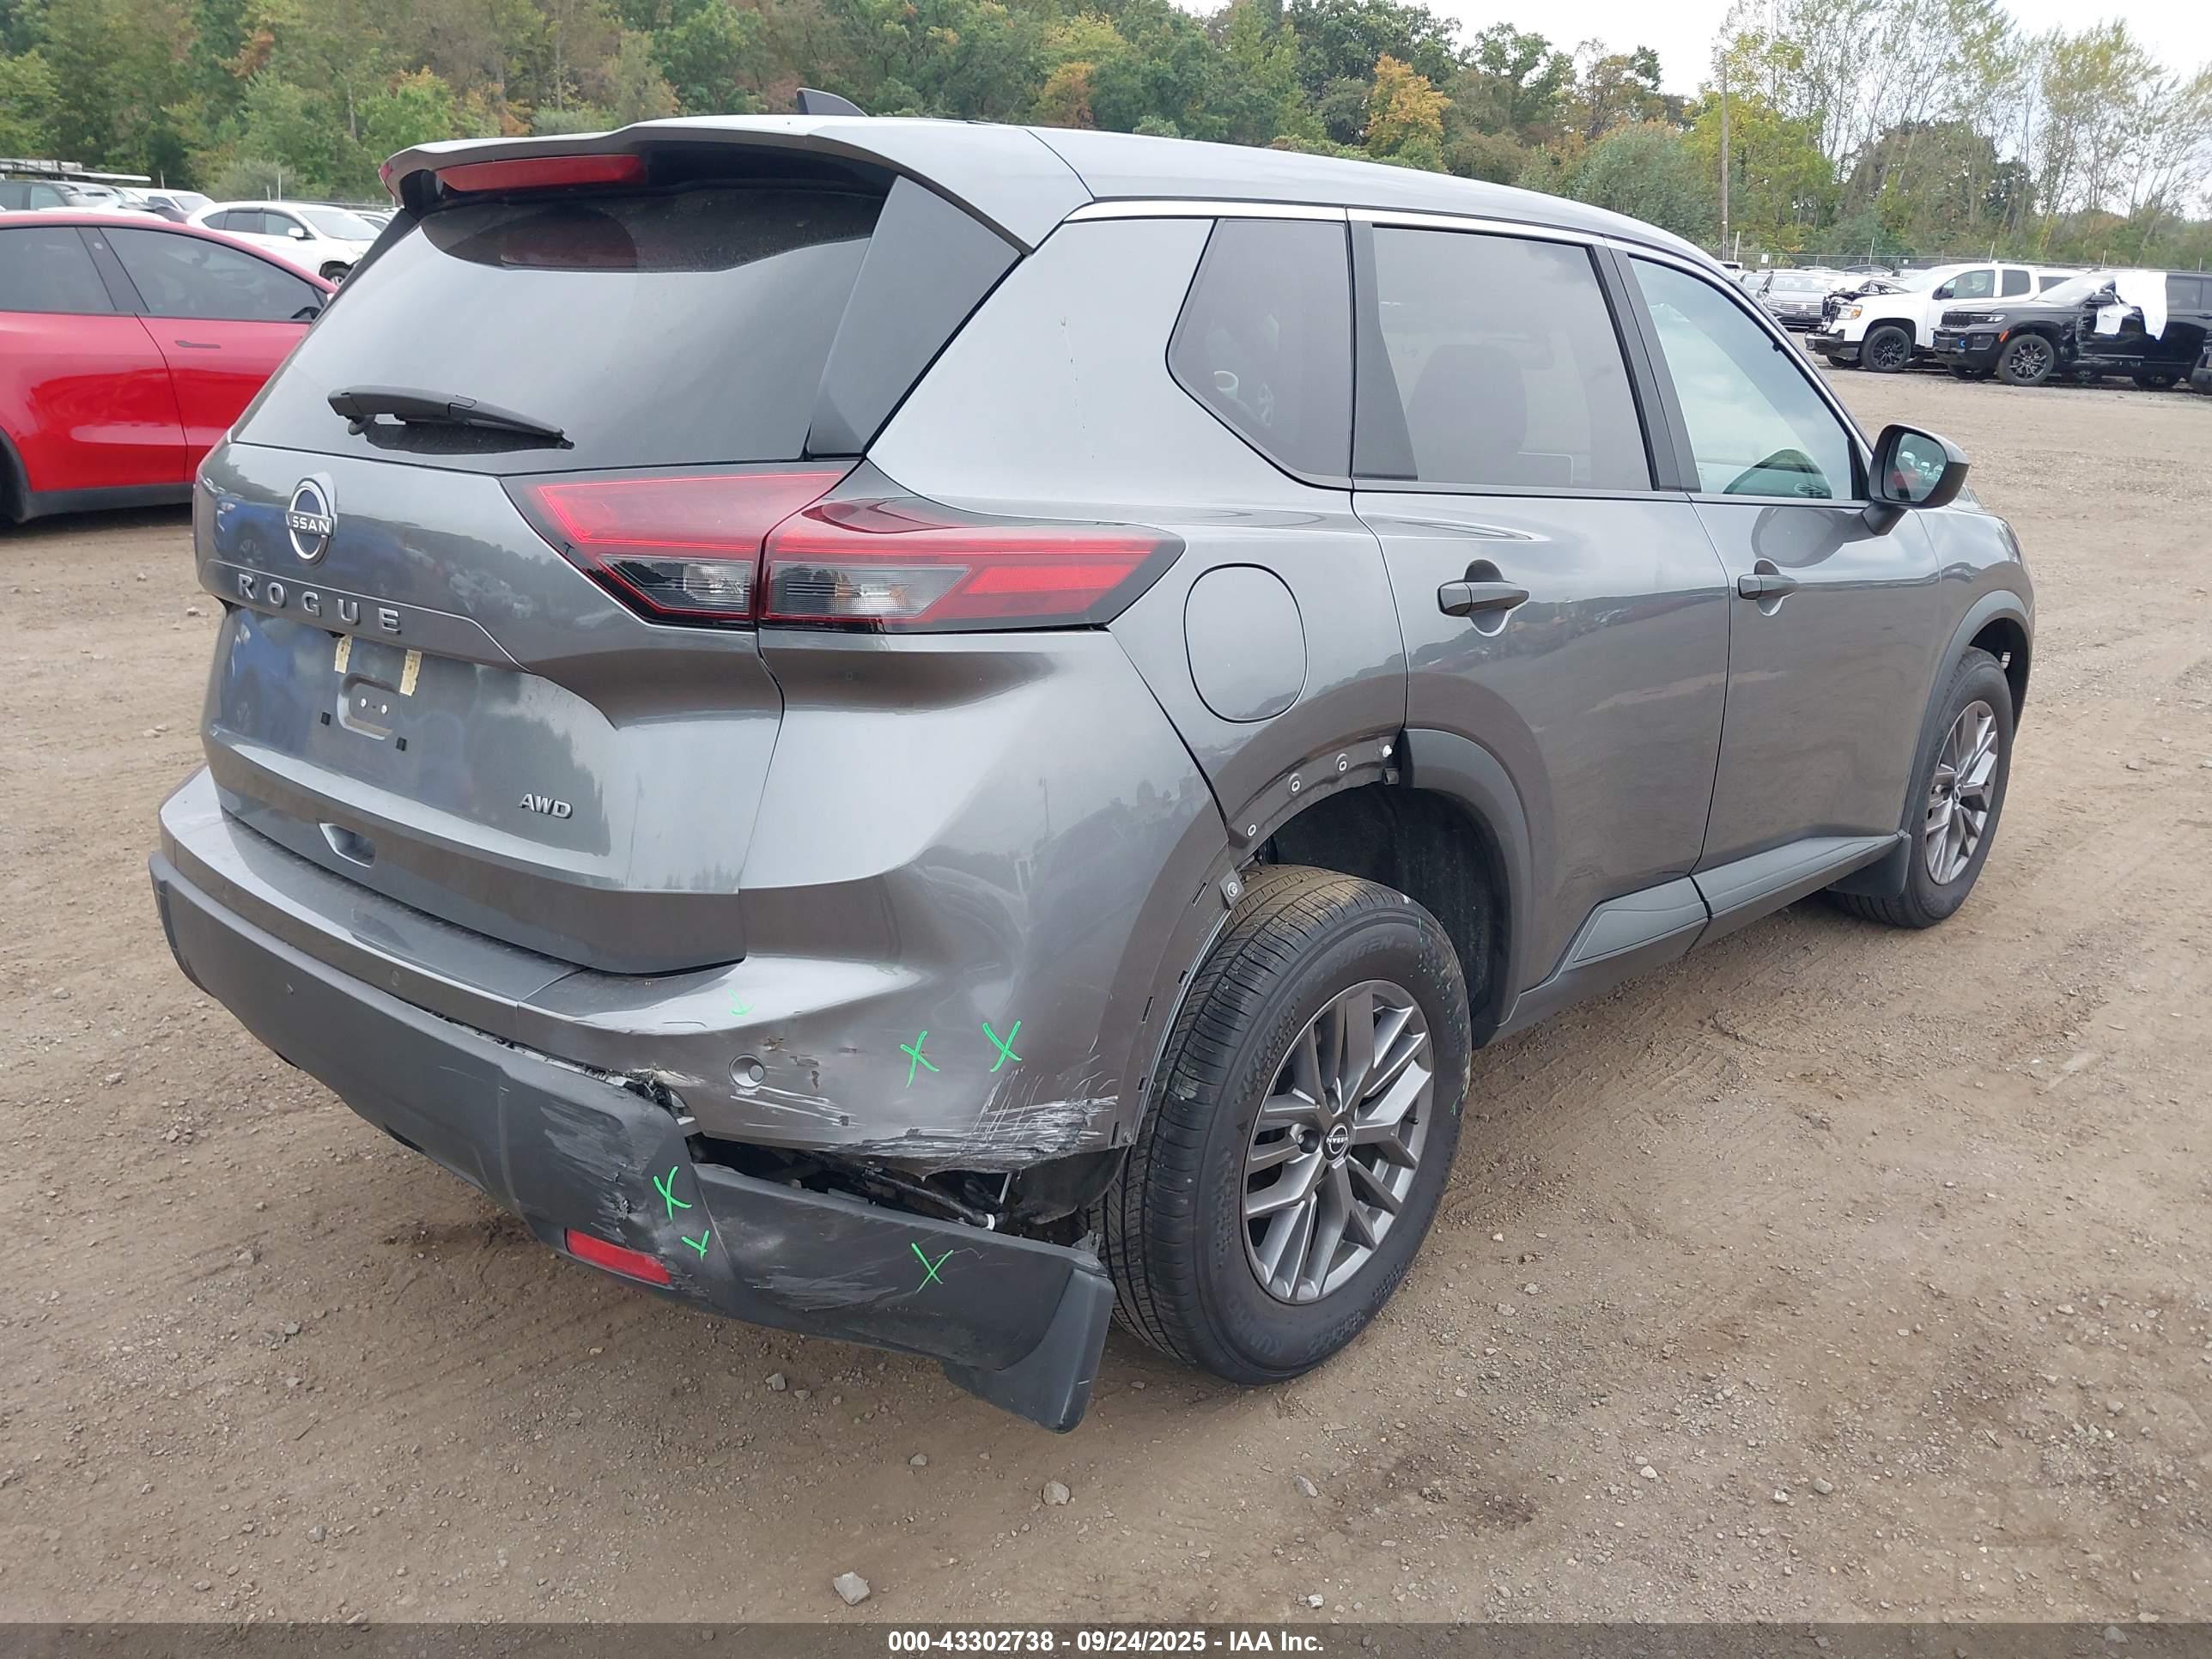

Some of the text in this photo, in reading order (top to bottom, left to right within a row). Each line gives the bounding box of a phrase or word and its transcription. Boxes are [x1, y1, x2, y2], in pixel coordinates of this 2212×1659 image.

[292, 515, 331, 533] SSAN
[238, 573, 401, 635] ROGUE
[518, 793, 573, 819] AWD
